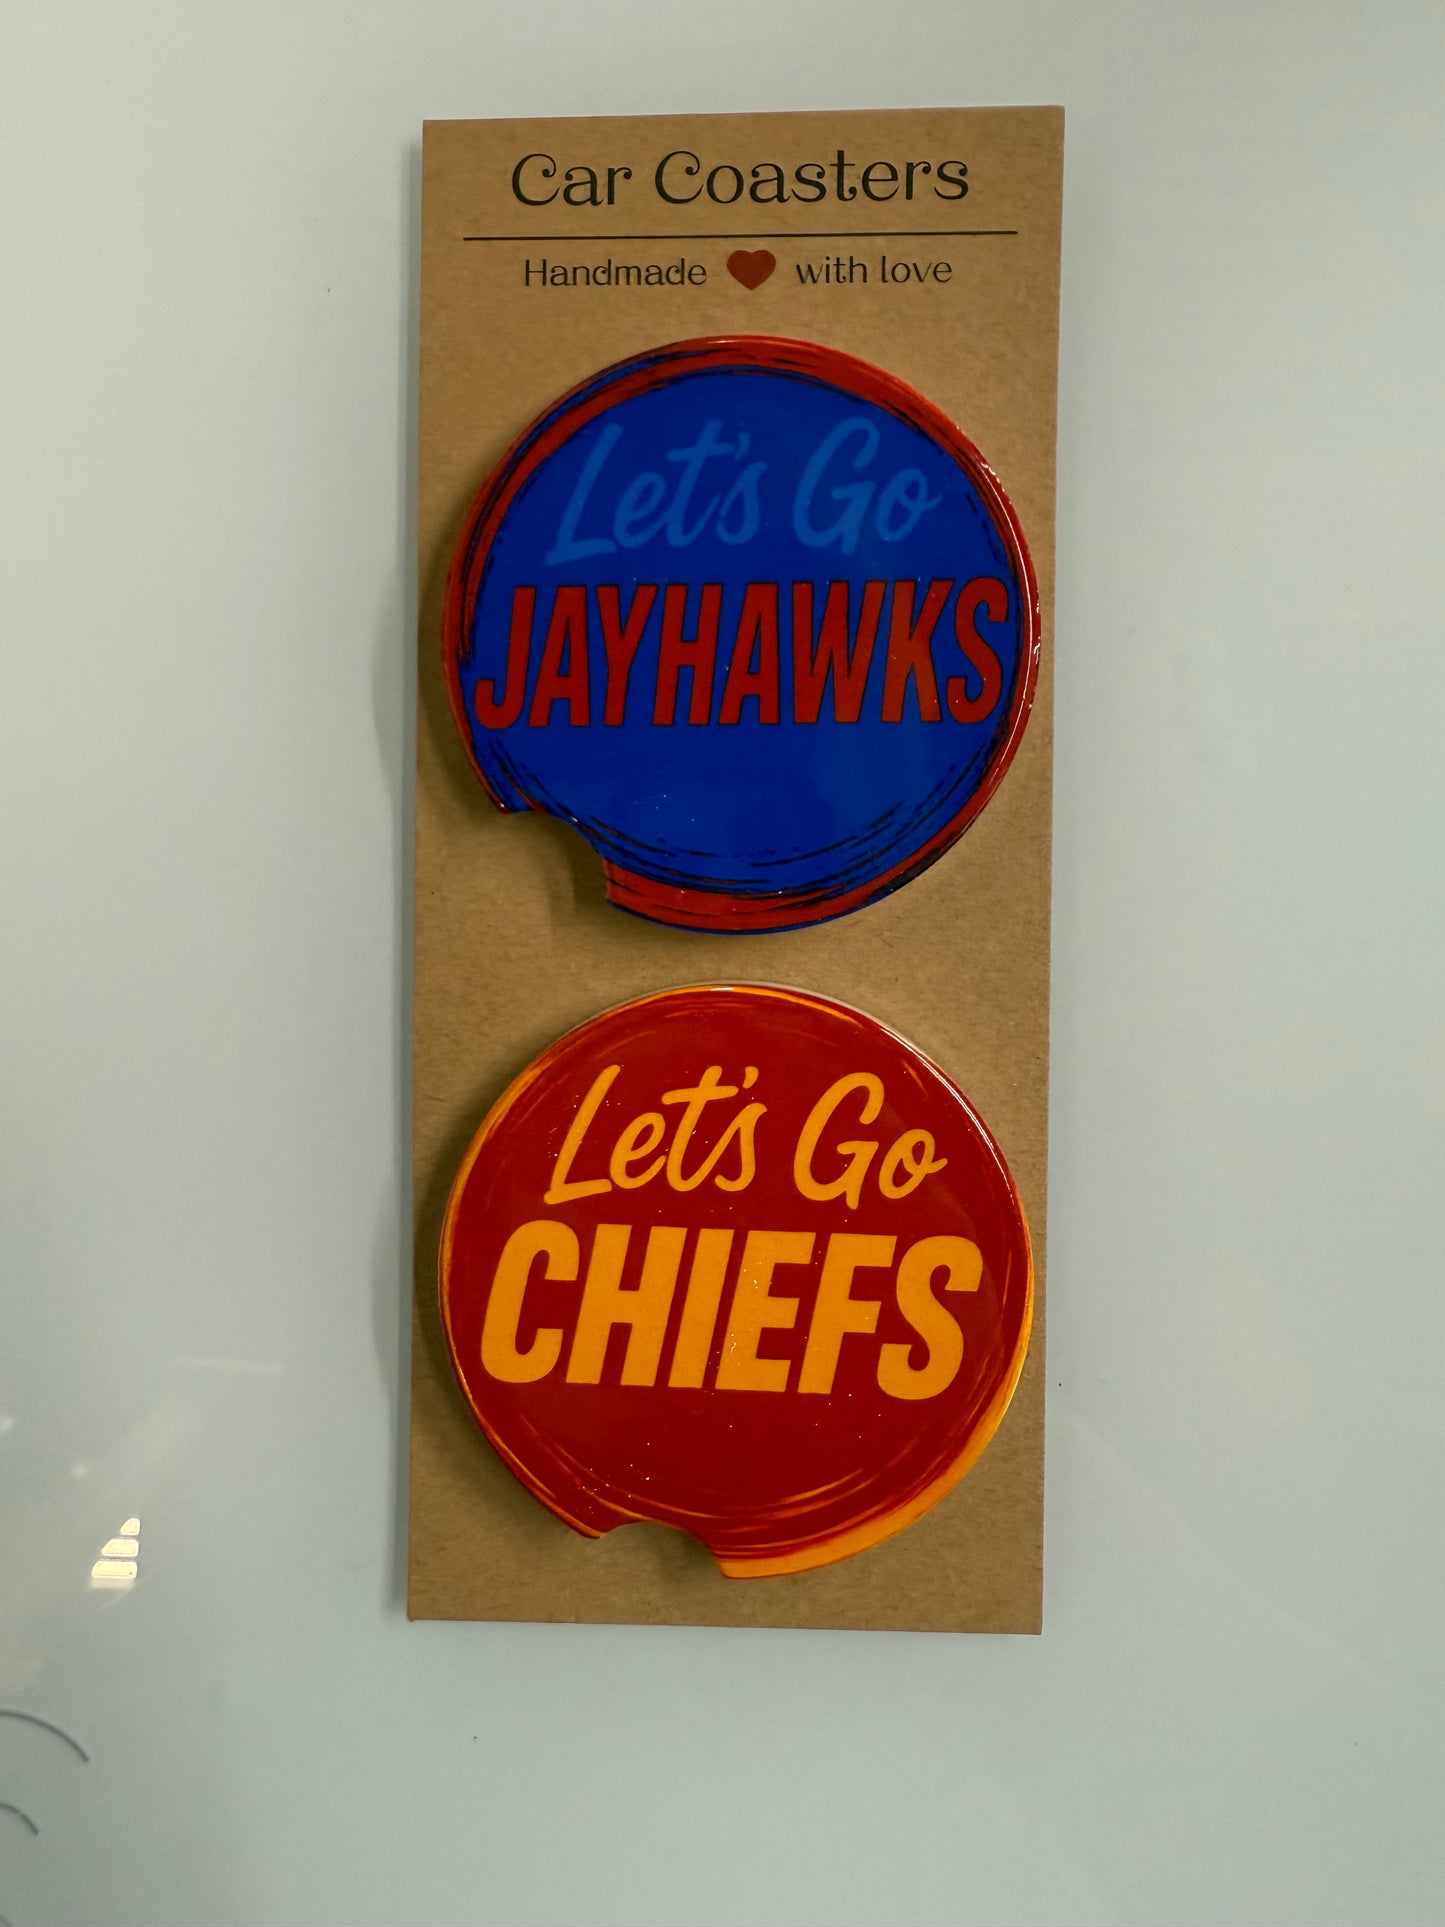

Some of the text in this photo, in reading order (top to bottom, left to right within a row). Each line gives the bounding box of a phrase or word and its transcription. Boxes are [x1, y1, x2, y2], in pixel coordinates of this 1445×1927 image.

[511, 150, 970, 206] Car Coasters
[525, 255, 954, 287] Handmade with love
[544, 417, 942, 566] Let's Go
[473, 577, 1009, 730] JAYHAWKS
[543, 1064, 949, 1210] Let's Go
[480, 1219, 984, 1401] CHIEFS
